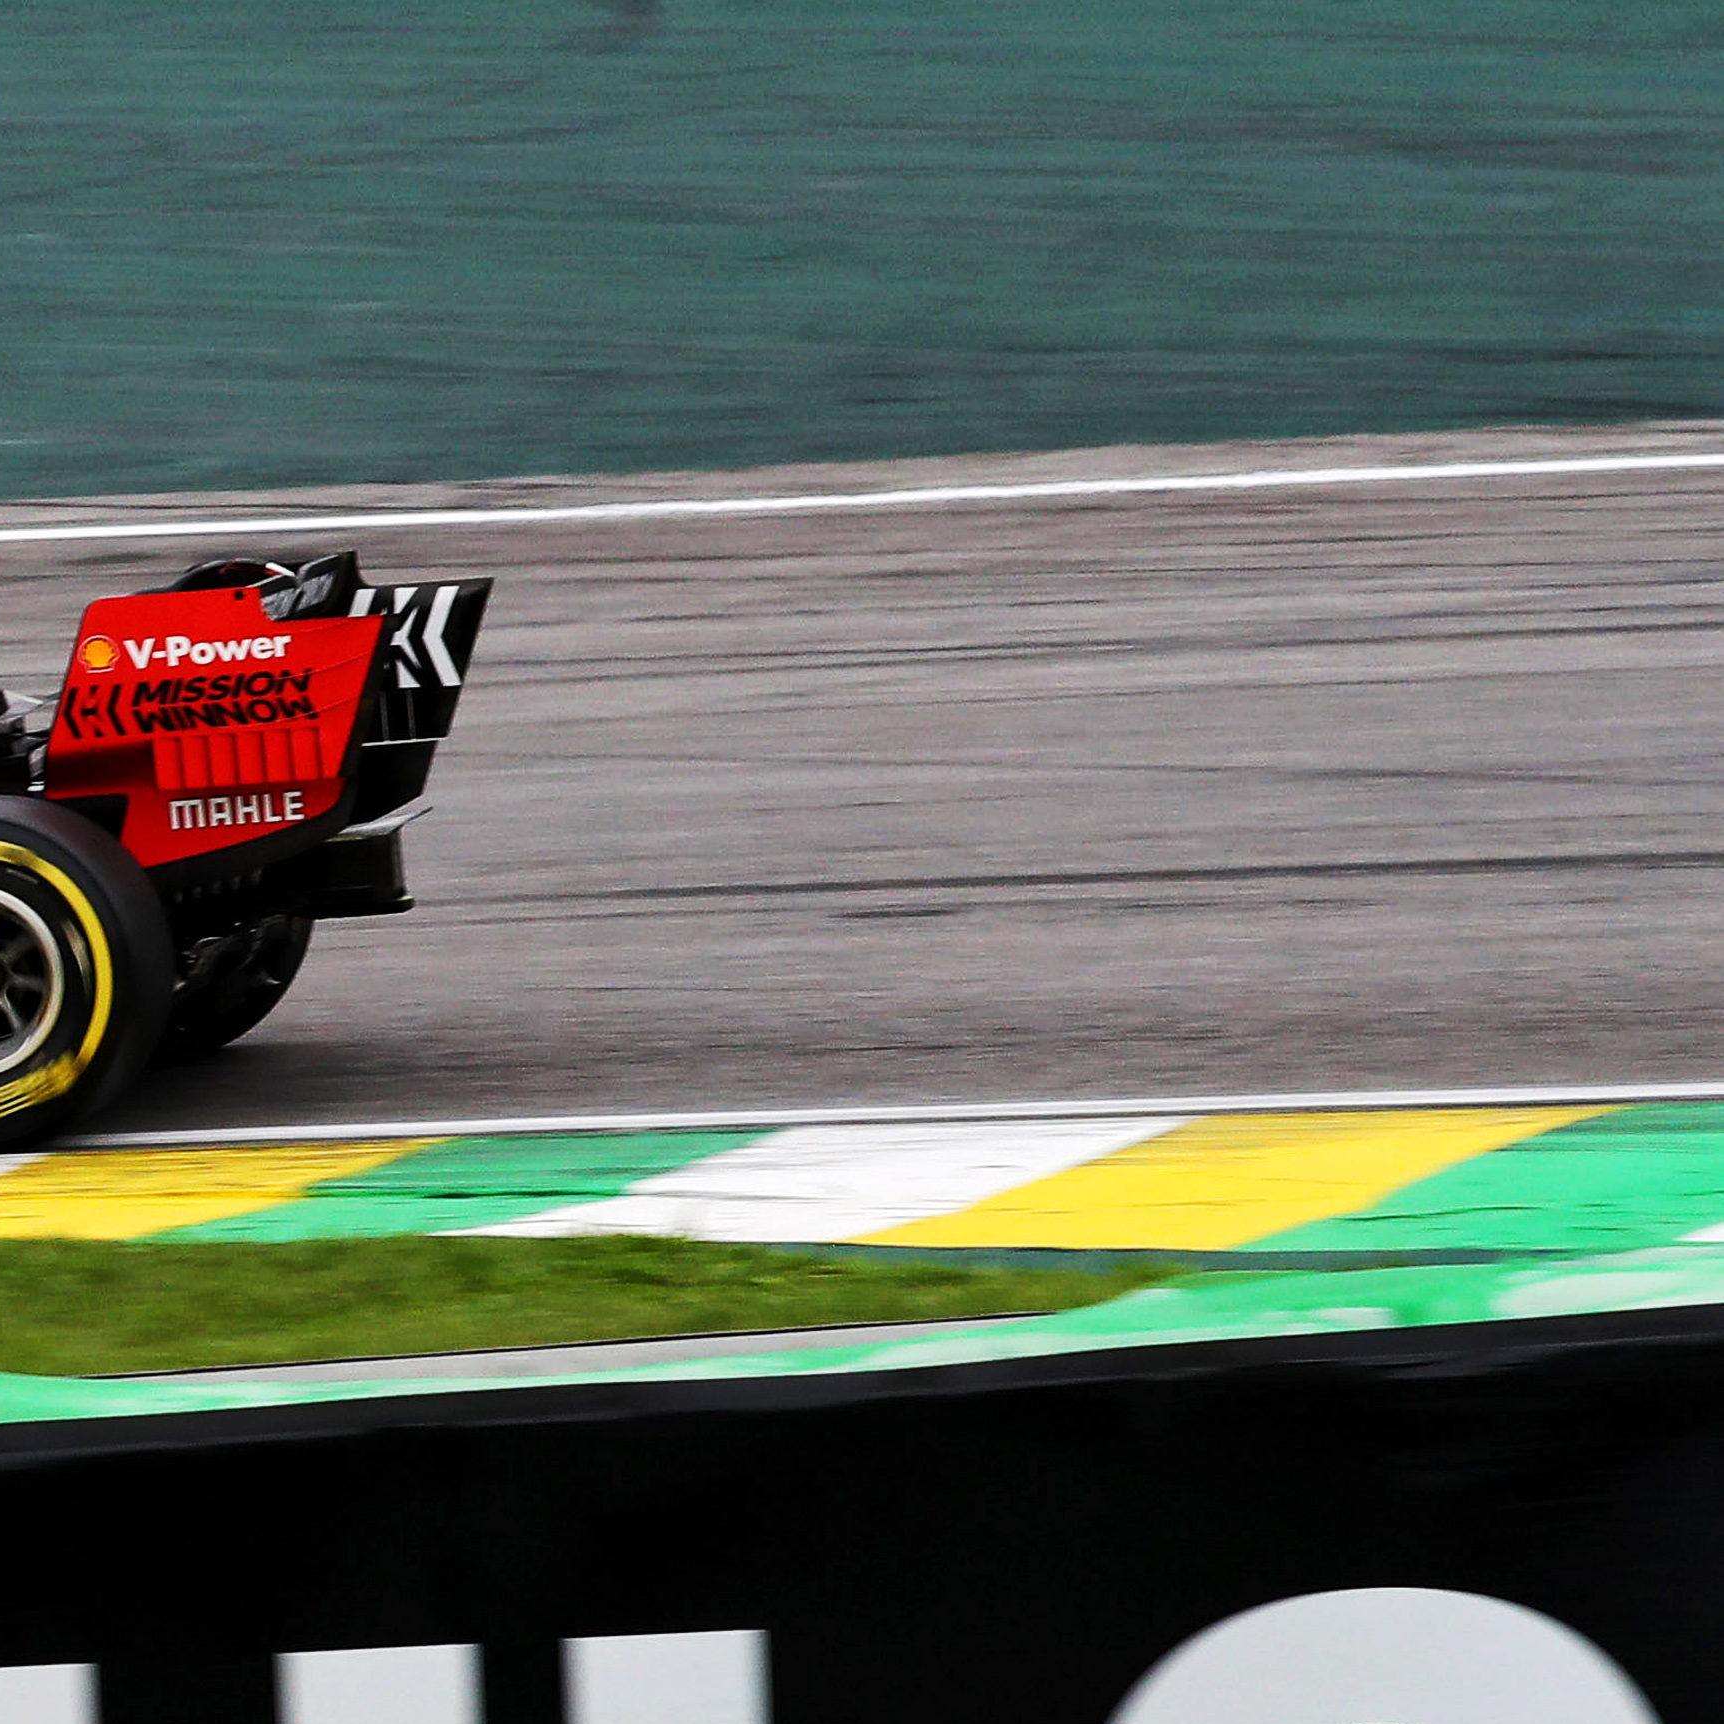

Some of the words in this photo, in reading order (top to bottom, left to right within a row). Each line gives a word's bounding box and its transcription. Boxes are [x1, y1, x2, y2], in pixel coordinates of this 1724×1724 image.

[124, 636, 292, 669] V-Power
[131, 668, 312, 706] MISSION
[132, 696, 319, 734] WINNOW
[170, 791, 305, 830] MAHLE
